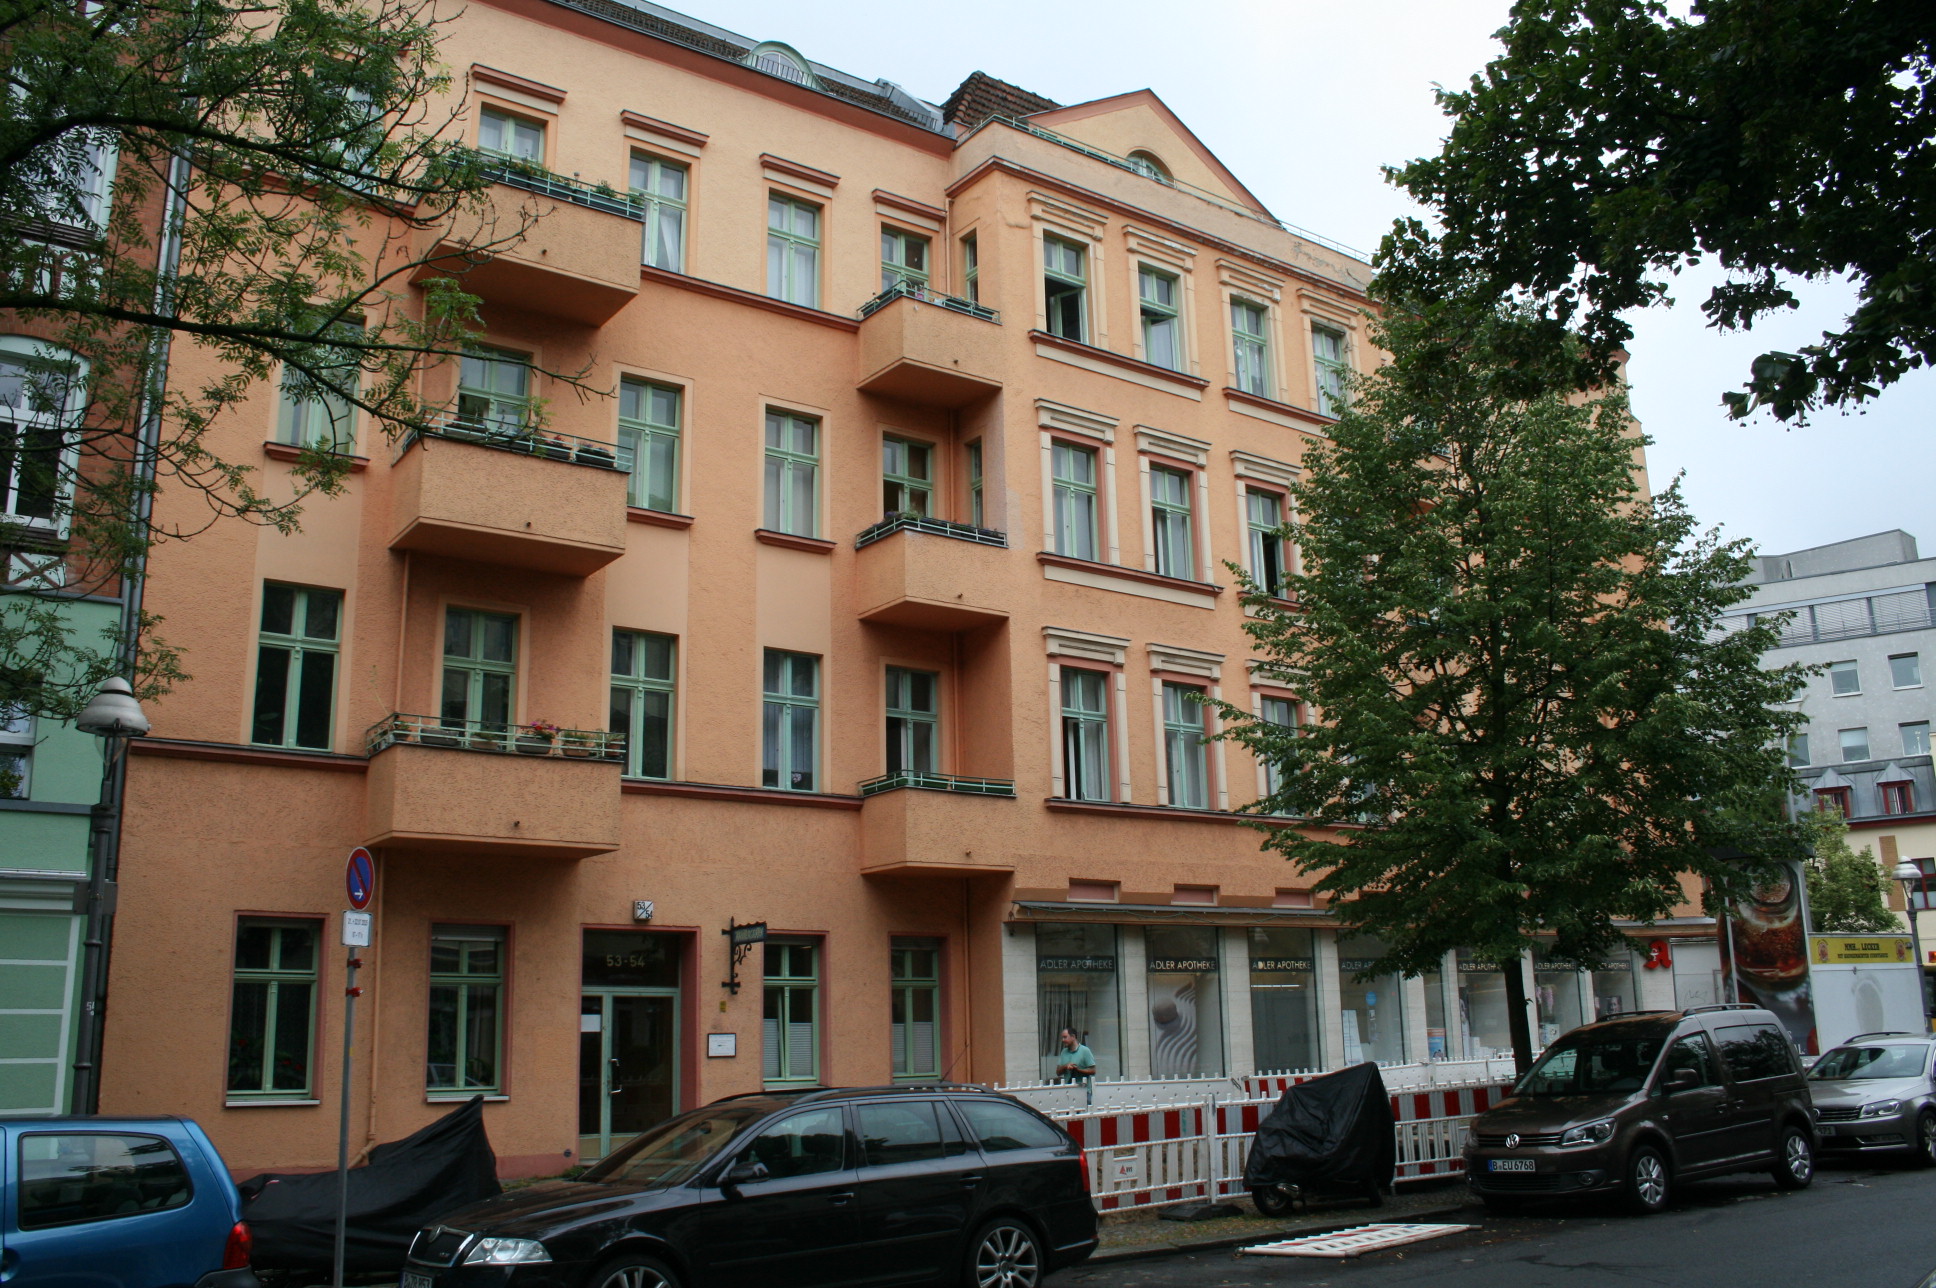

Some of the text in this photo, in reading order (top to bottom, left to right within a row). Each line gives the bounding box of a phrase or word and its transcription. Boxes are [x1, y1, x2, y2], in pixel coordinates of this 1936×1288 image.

[637, 901, 646, 910] 53
[645, 910, 653, 919] 54
[1040, 959, 1113, 969] ADLER APOTHEKE
[1149, 960, 1215, 970] ADLER APOTHEKE
[1252, 960, 1311, 970] ADLER APOTHEKE
[1341, 961, 1362, 970] ADLER
[1459, 962, 1476, 971] ADLER
[1535, 962, 1550, 970] ADLER
[1492, 1161, 1498, 1170] B
[1514, 1161, 1534, 1170] 6768
